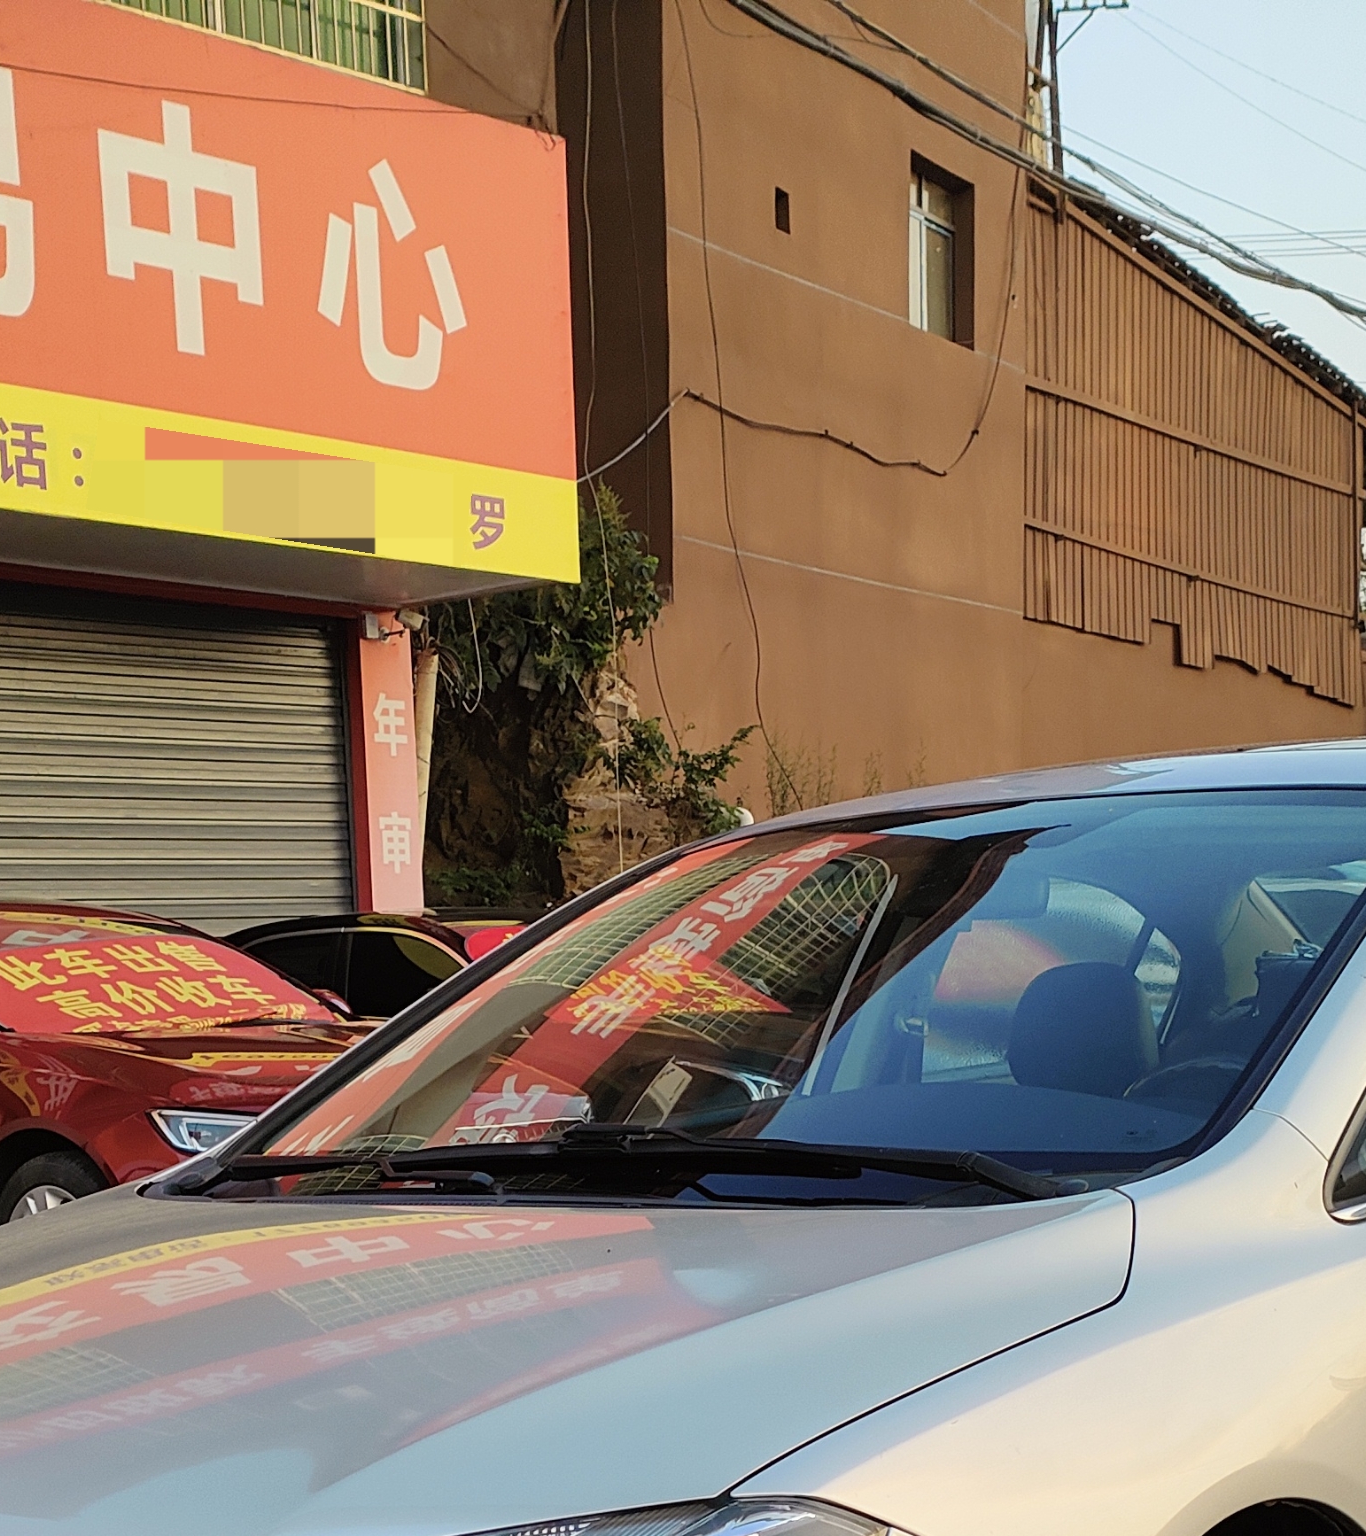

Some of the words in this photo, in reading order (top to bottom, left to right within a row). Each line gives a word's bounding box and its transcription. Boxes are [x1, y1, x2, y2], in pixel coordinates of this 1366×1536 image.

[470, 493, 505, 550] 罗
[372, 692, 412, 874] 年审
[36, 974, 277, 1020] 高价收车
